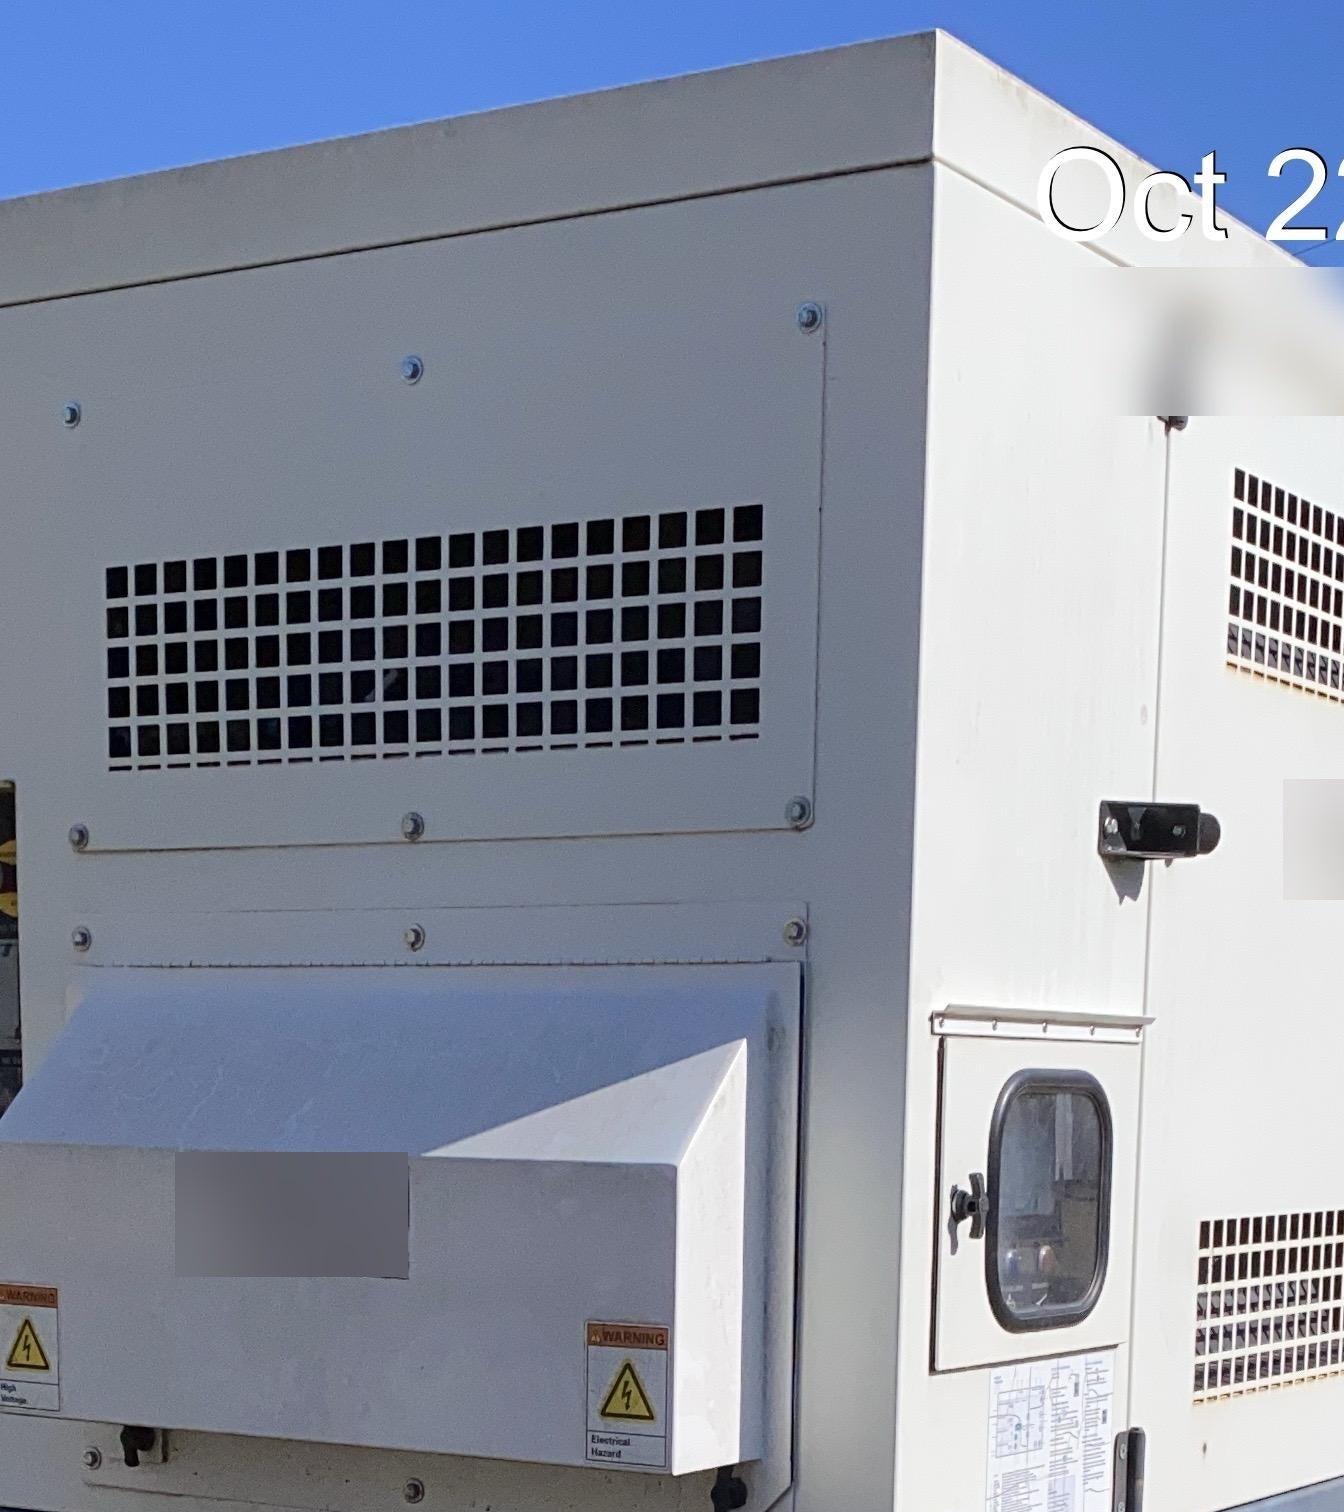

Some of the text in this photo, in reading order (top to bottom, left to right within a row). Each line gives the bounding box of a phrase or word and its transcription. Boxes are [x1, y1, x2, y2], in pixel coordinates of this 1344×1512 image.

[6, 1289, 55, 1304] WARNING
[602, 1330, 665, 1346] WARNING
[591, 1435, 631, 1447] Electrical
[591, 1447, 622, 1458] Hazard
